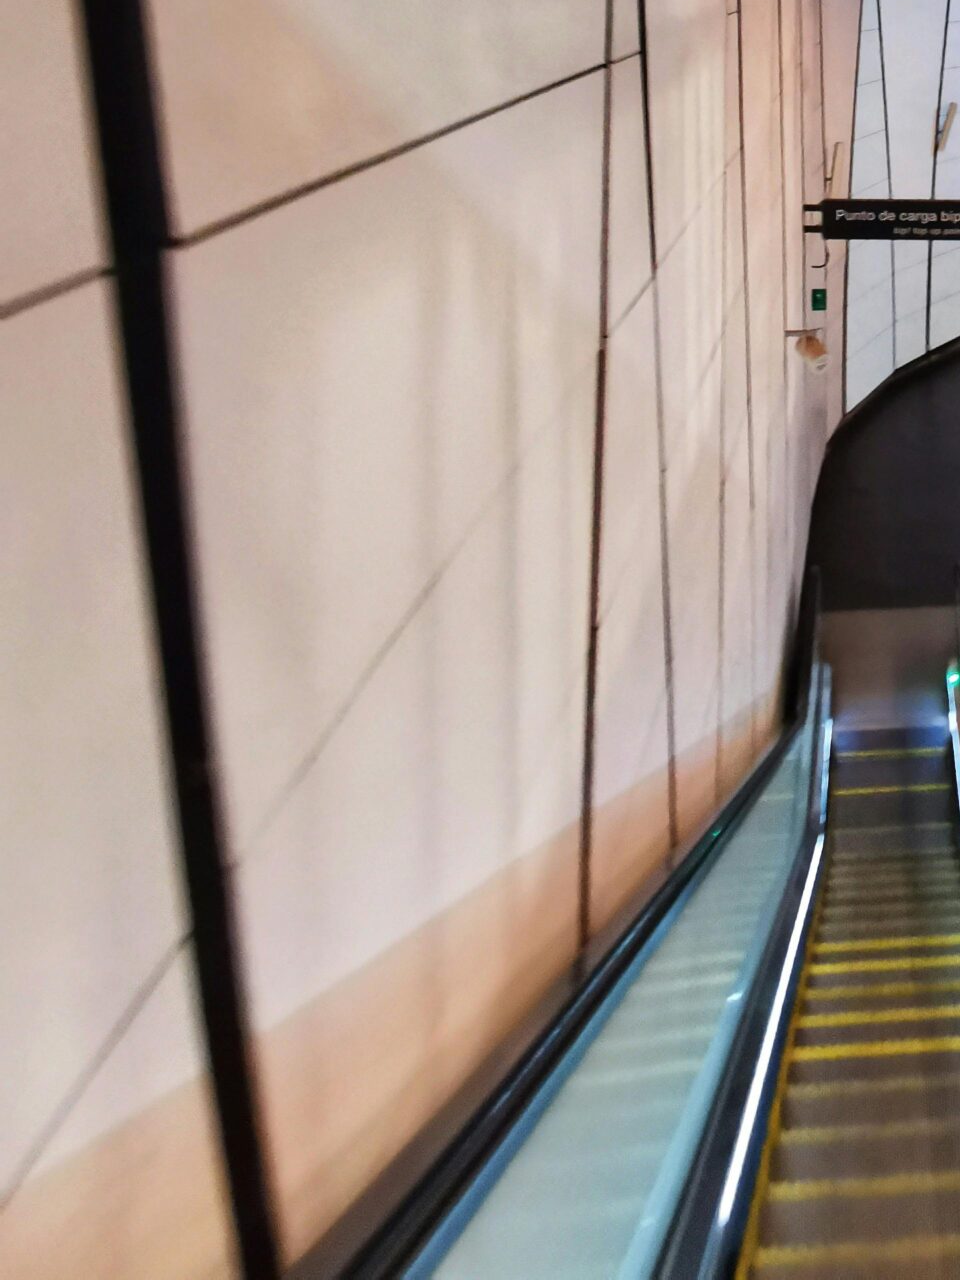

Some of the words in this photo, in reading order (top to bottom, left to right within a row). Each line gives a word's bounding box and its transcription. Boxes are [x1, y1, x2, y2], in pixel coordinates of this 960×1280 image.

[835, 209, 876, 221] Punto
[878, 210, 896, 221] de
[899, 212, 938, 224] carga
